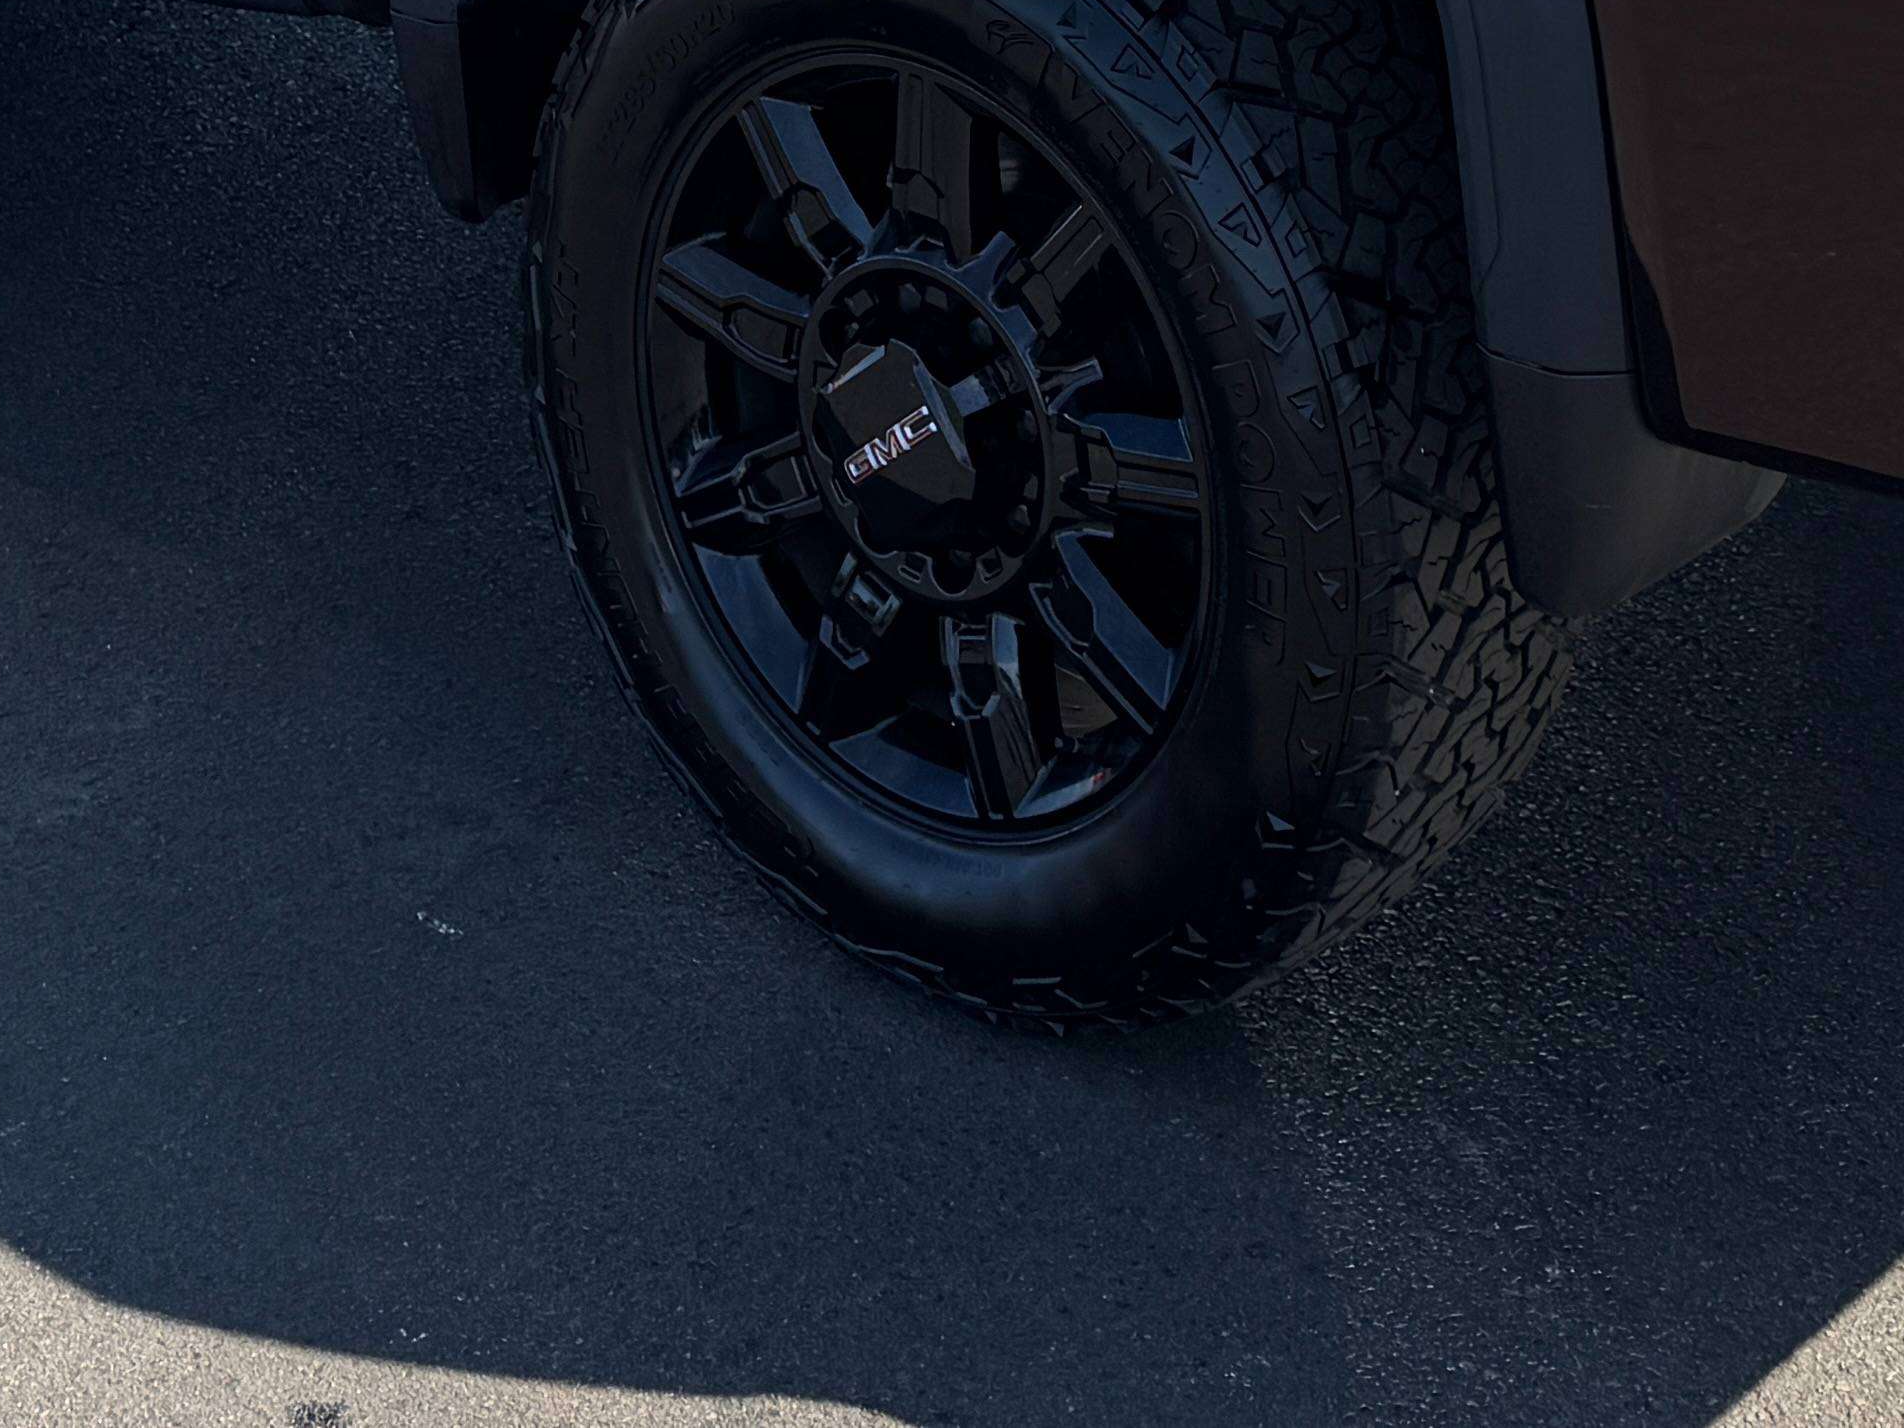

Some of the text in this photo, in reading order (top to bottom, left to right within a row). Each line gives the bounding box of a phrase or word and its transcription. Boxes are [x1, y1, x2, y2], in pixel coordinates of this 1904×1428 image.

[844, 404, 939, 485] GMC
[1050, 57, 1288, 668] VENOM POWER
